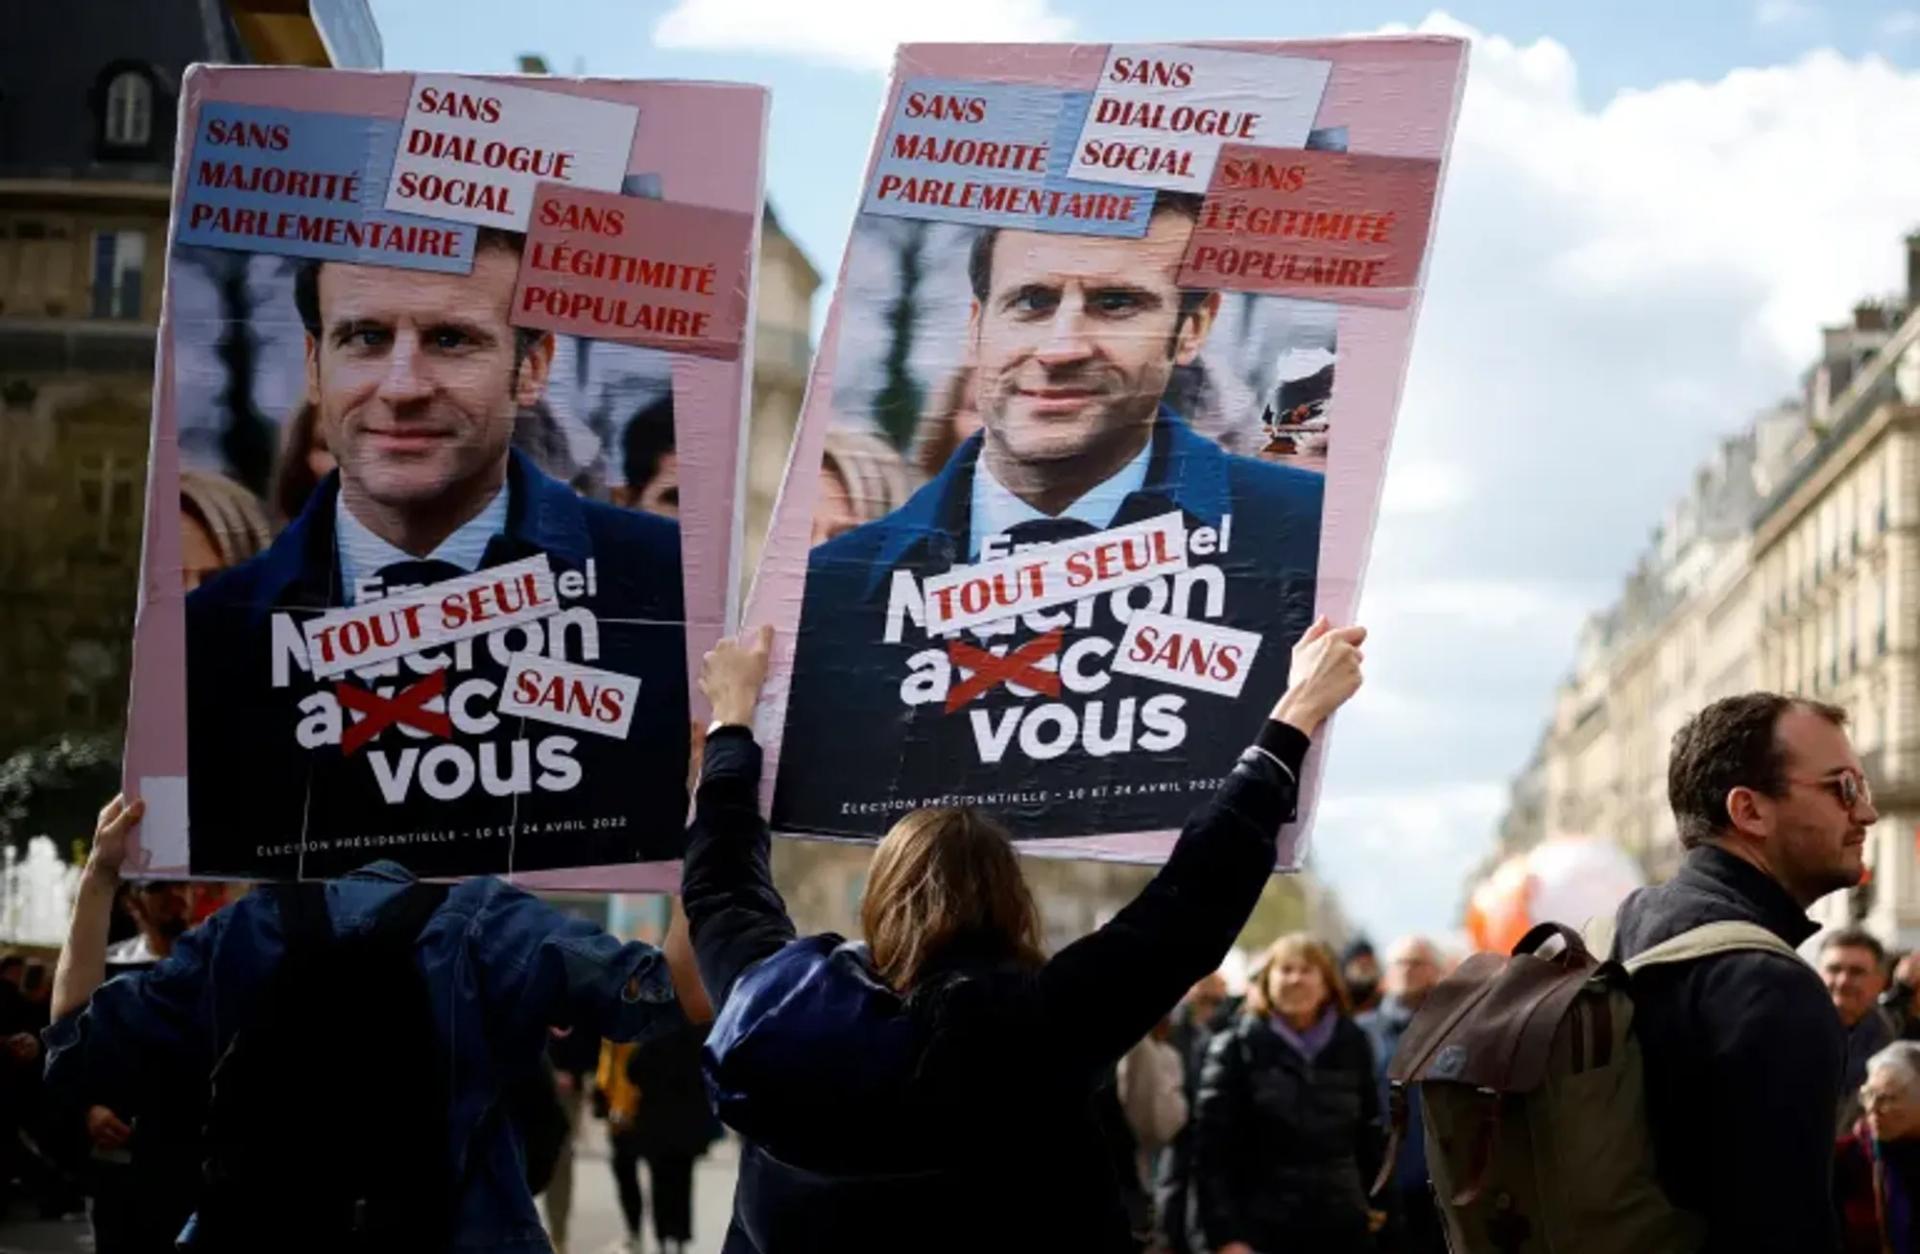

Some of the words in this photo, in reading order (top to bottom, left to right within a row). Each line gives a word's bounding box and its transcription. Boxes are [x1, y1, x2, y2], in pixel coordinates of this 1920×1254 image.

[1110, 57, 1193, 88] SANS
[416, 87, 502, 124] SANS
[904, 92, 987, 124] SANS
[1095, 98, 1261, 139] DIALOGUE
[206, 119, 290, 151] SANS
[407, 129, 575, 181] DIALOGUE
[893, 133, 1050, 172] MAJORITÉ
[1080, 140, 1196, 178] SOCIAL
[1221, 159, 1306, 192] SANS
[197, 160, 360, 202] MAJORITÉ
[396, 172, 515, 215] SOCIAL
[877, 174, 1138, 223] PARLEMENTAIRE
[190, 204, 462, 259] PARLEMENTAIRE
[538, 199, 624, 236] SANS
[1205, 202, 1396, 244] LÉGITIMITÉ
[531, 240, 717, 296] LÉGITIMITÉ
[1193, 245, 1385, 289] POPULAIRE
[523, 286, 710, 337] POPULAIRE
[931, 561, 1048, 621] TOUT
[1066, 530, 1181, 588] SEUL
[312, 603, 426, 663] TOUT
[441, 573, 552, 630] SEUL
[900, 636, 1115, 705] ac
[1129, 626, 1242, 682] SANS
[296, 678, 500, 750] ac
[513, 669, 625, 724] SANS
[969, 693, 1187, 763] vous
[367, 735, 582, 804] vous
[1114, 785, 1131, 796] 24
[1137, 781, 1181, 794] AVRIL
[522, 822, 539, 835] 24
[545, 819, 586, 832] AVRIL
[593, 816, 627, 829] 2022
